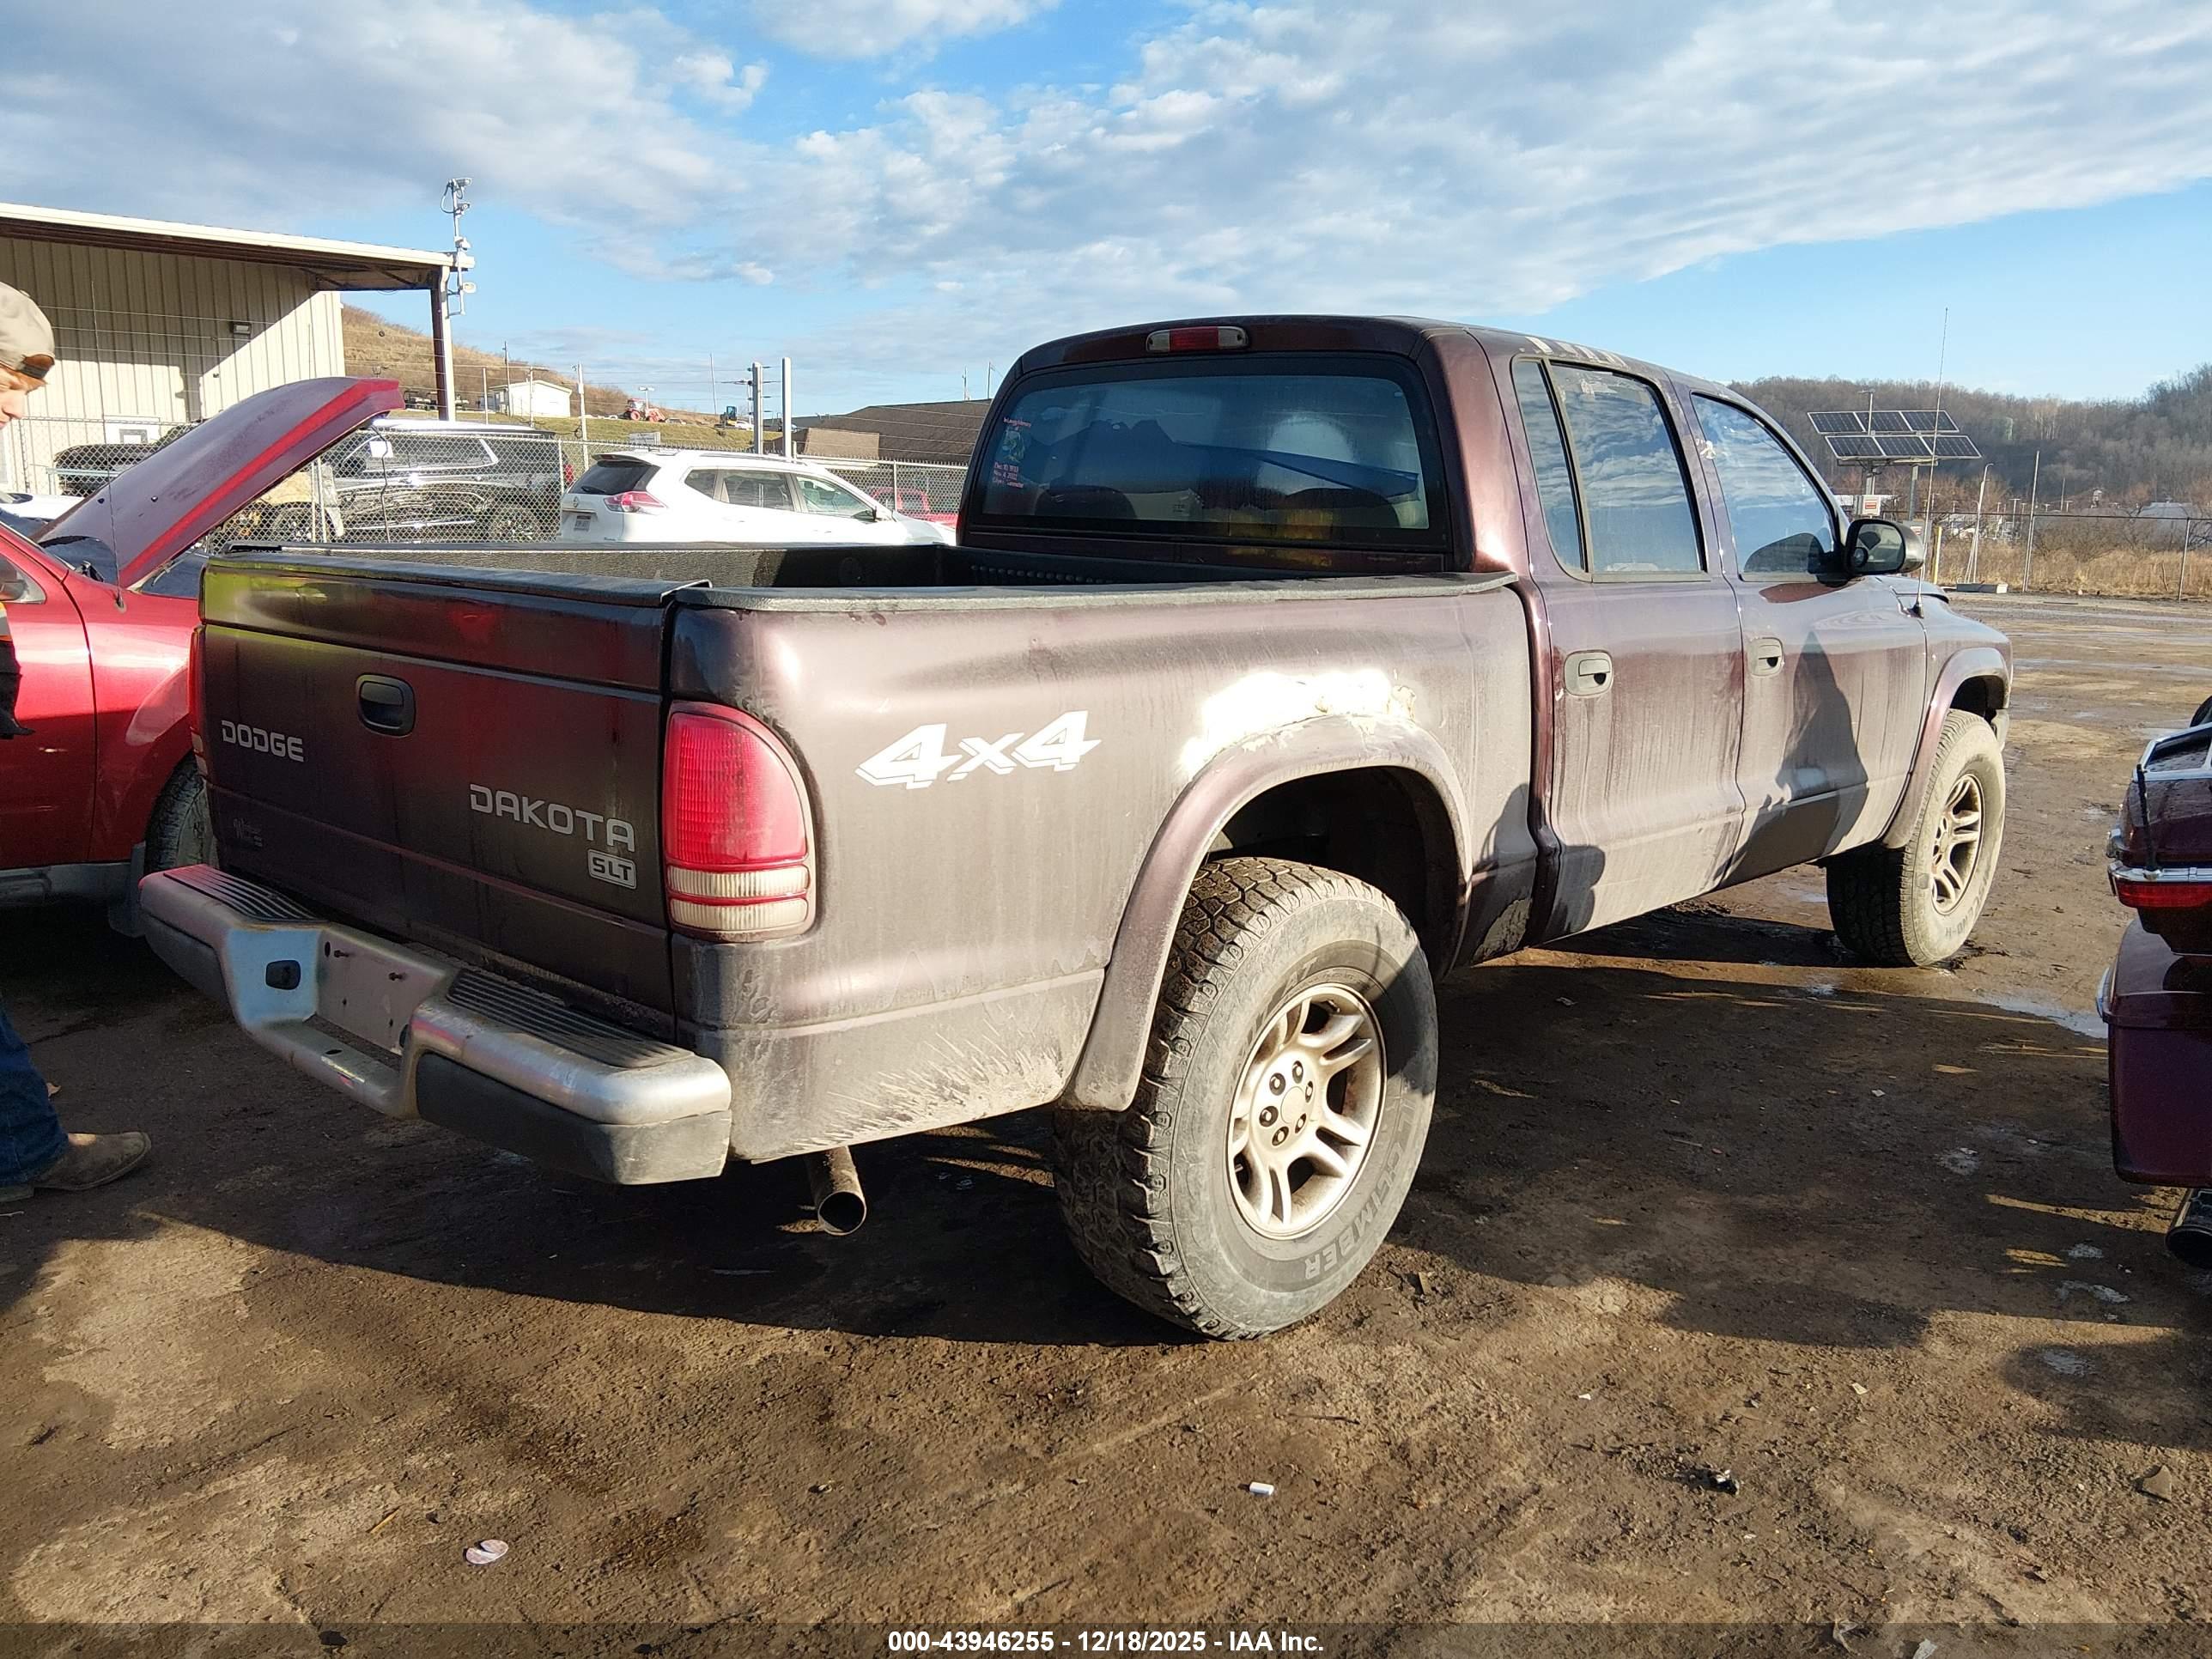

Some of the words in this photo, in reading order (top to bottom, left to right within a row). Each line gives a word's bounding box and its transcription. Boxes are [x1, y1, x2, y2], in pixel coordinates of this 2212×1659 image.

[221, 720, 305, 763] DODGE
[855, 710, 1102, 790] 4x4
[470, 783, 635, 853] DAKOTA
[592, 858, 632, 882] SLT
